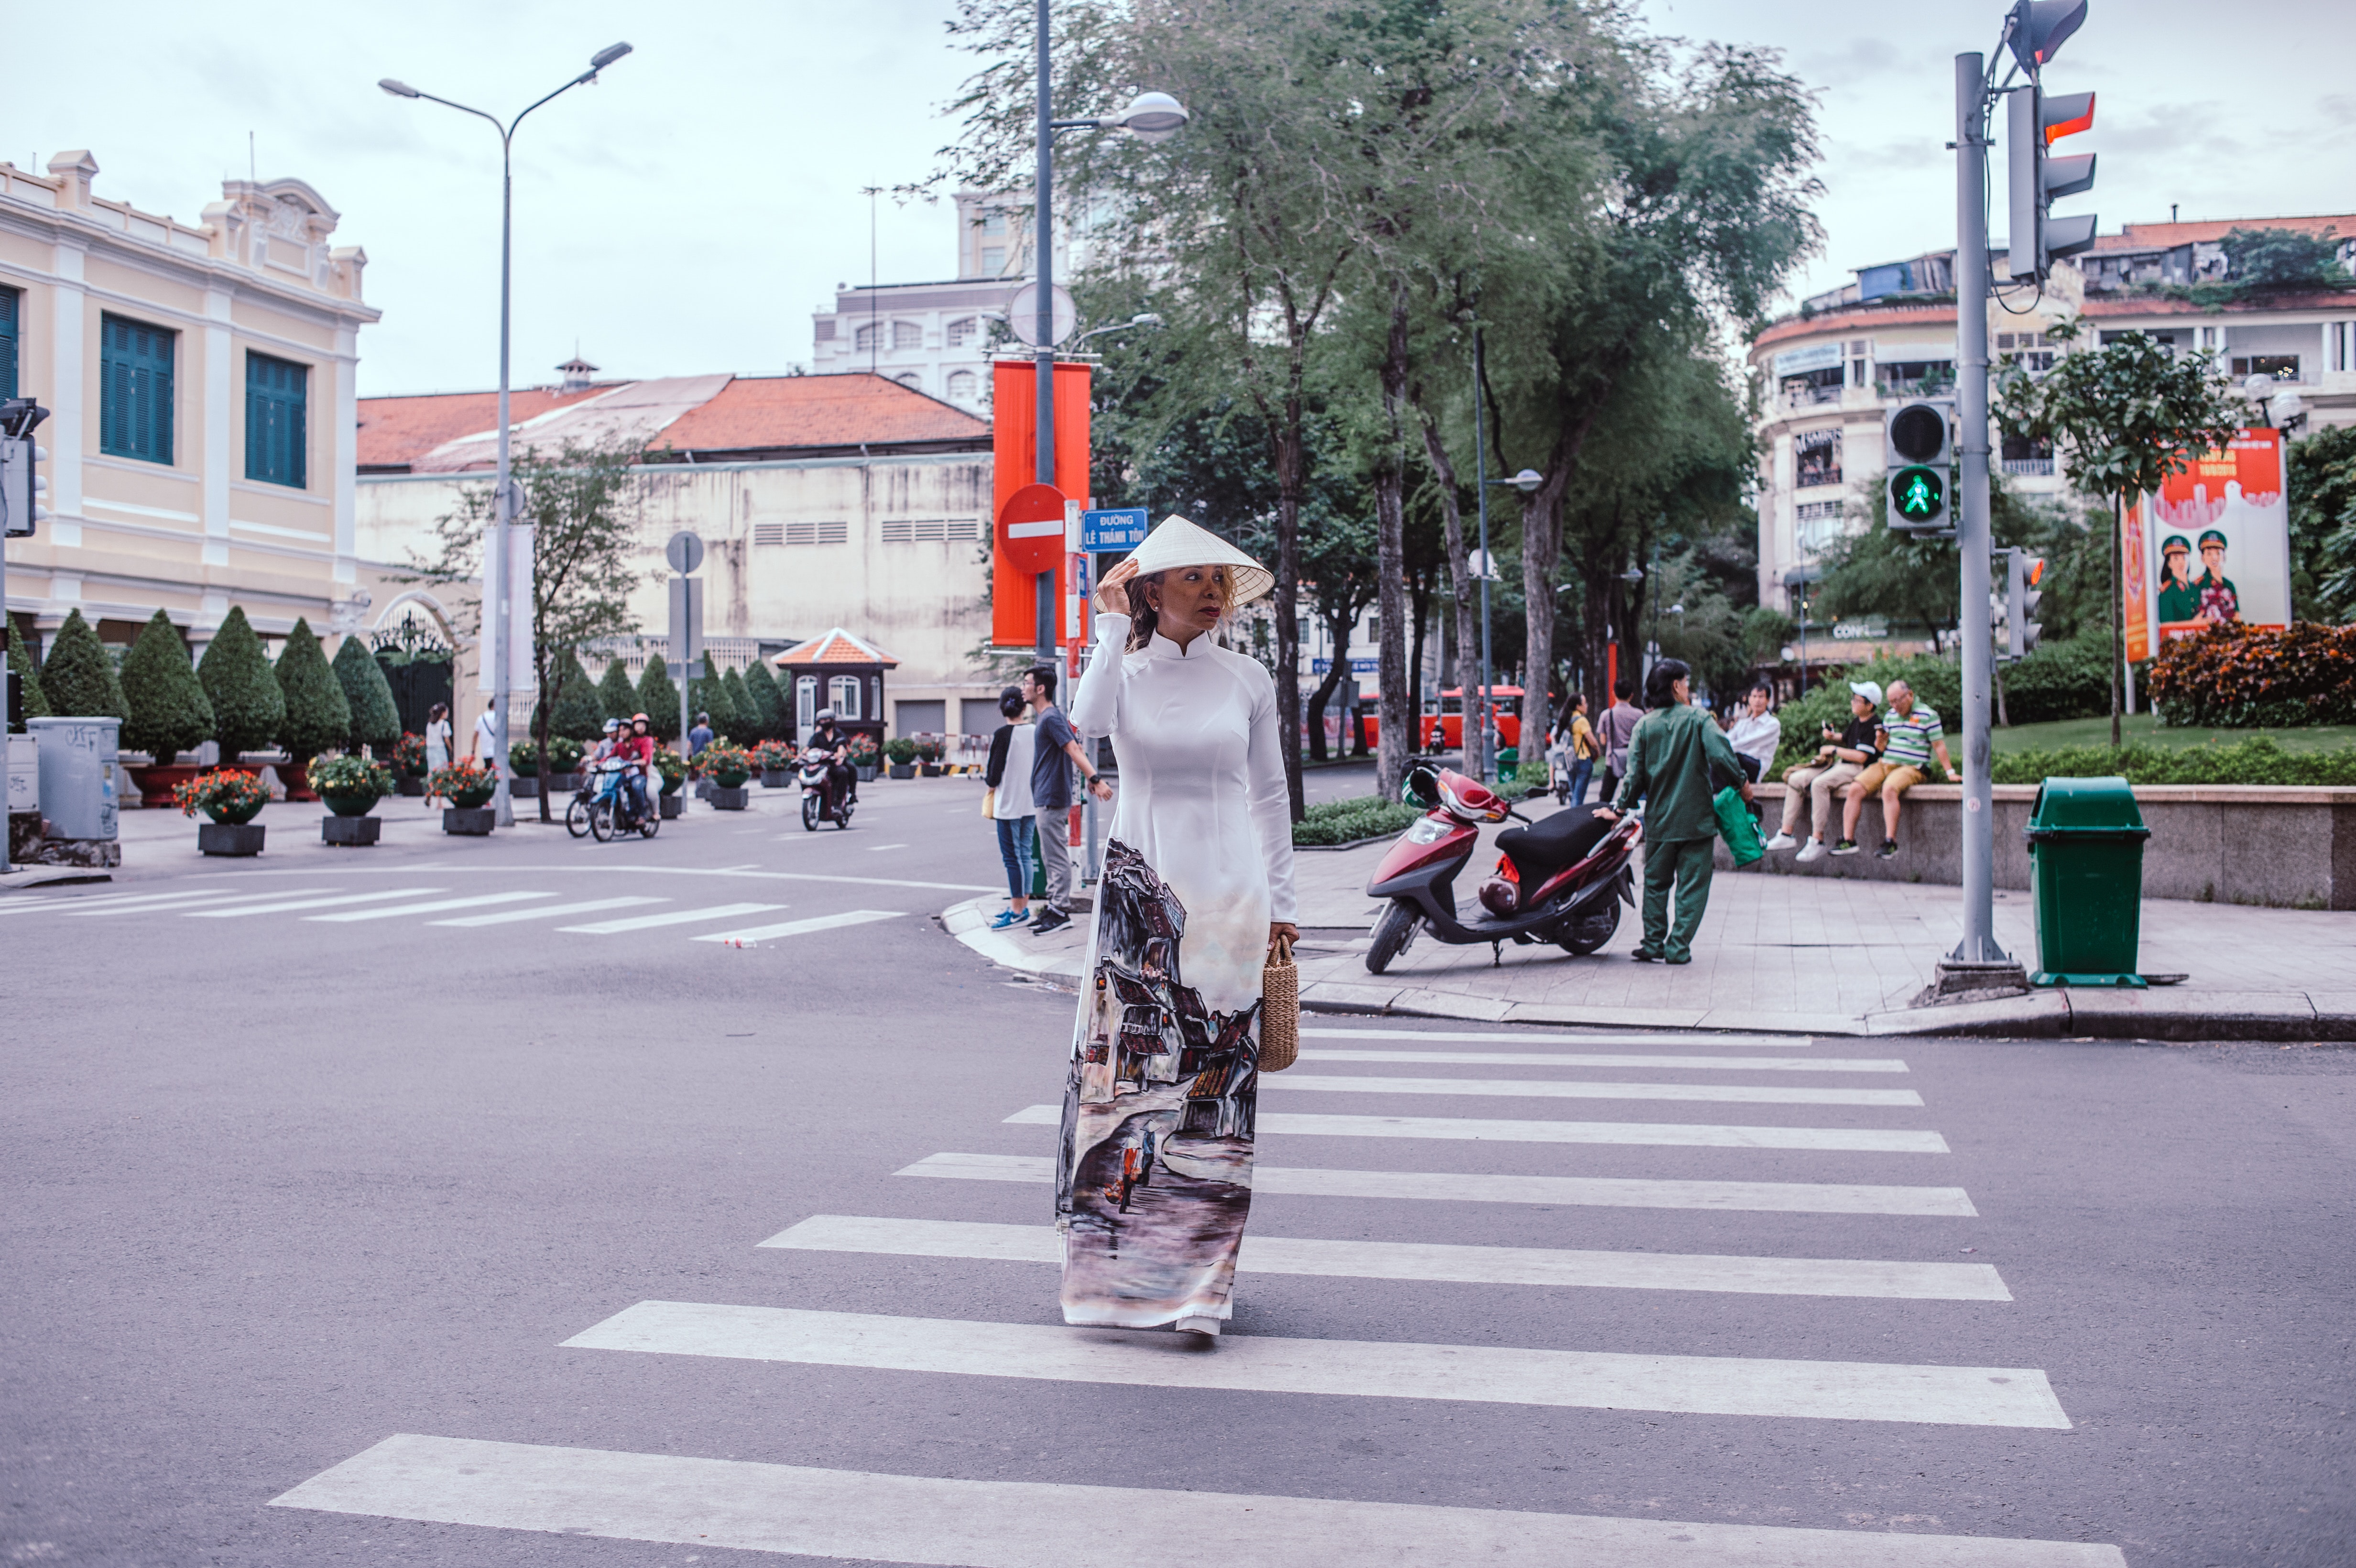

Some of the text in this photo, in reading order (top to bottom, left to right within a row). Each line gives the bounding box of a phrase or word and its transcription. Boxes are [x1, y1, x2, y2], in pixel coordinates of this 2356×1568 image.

[1086, 527, 1144, 544] LÊ THÁNH TÔN
